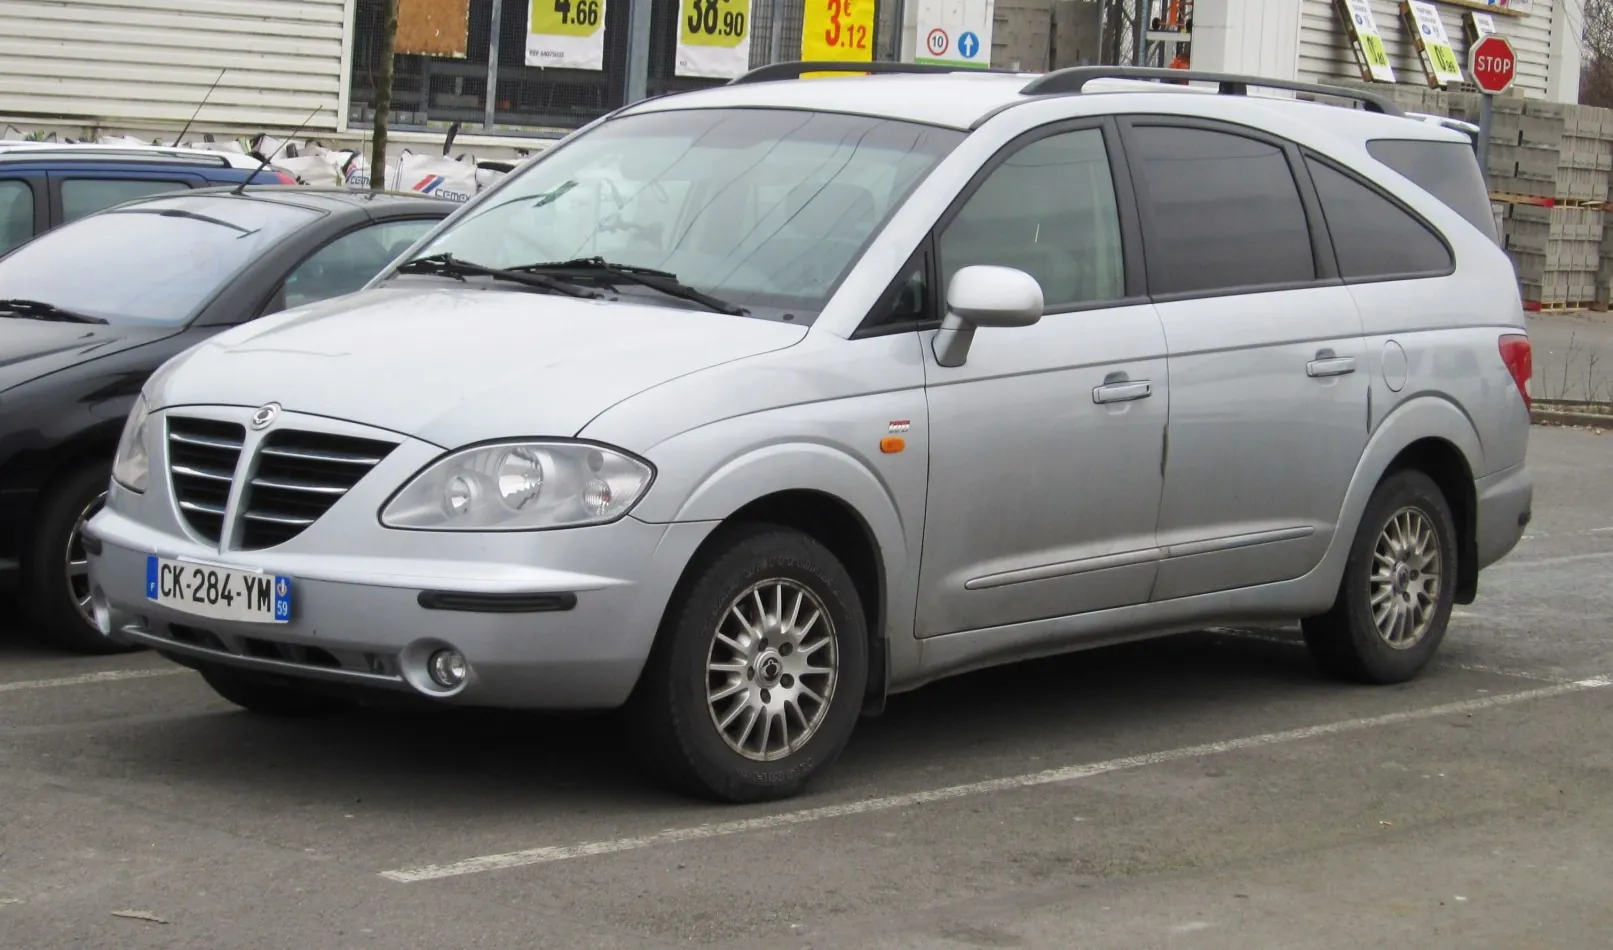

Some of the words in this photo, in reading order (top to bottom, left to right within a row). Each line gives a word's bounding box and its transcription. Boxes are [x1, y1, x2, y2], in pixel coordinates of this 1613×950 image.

[932, 35, 944, 48] 10
[1477, 55, 1511, 74] STOP
[350, 175, 371, 186] CEM
[160, 563, 272, 613] CK-284-YM
[277, 600, 288, 616] 59
